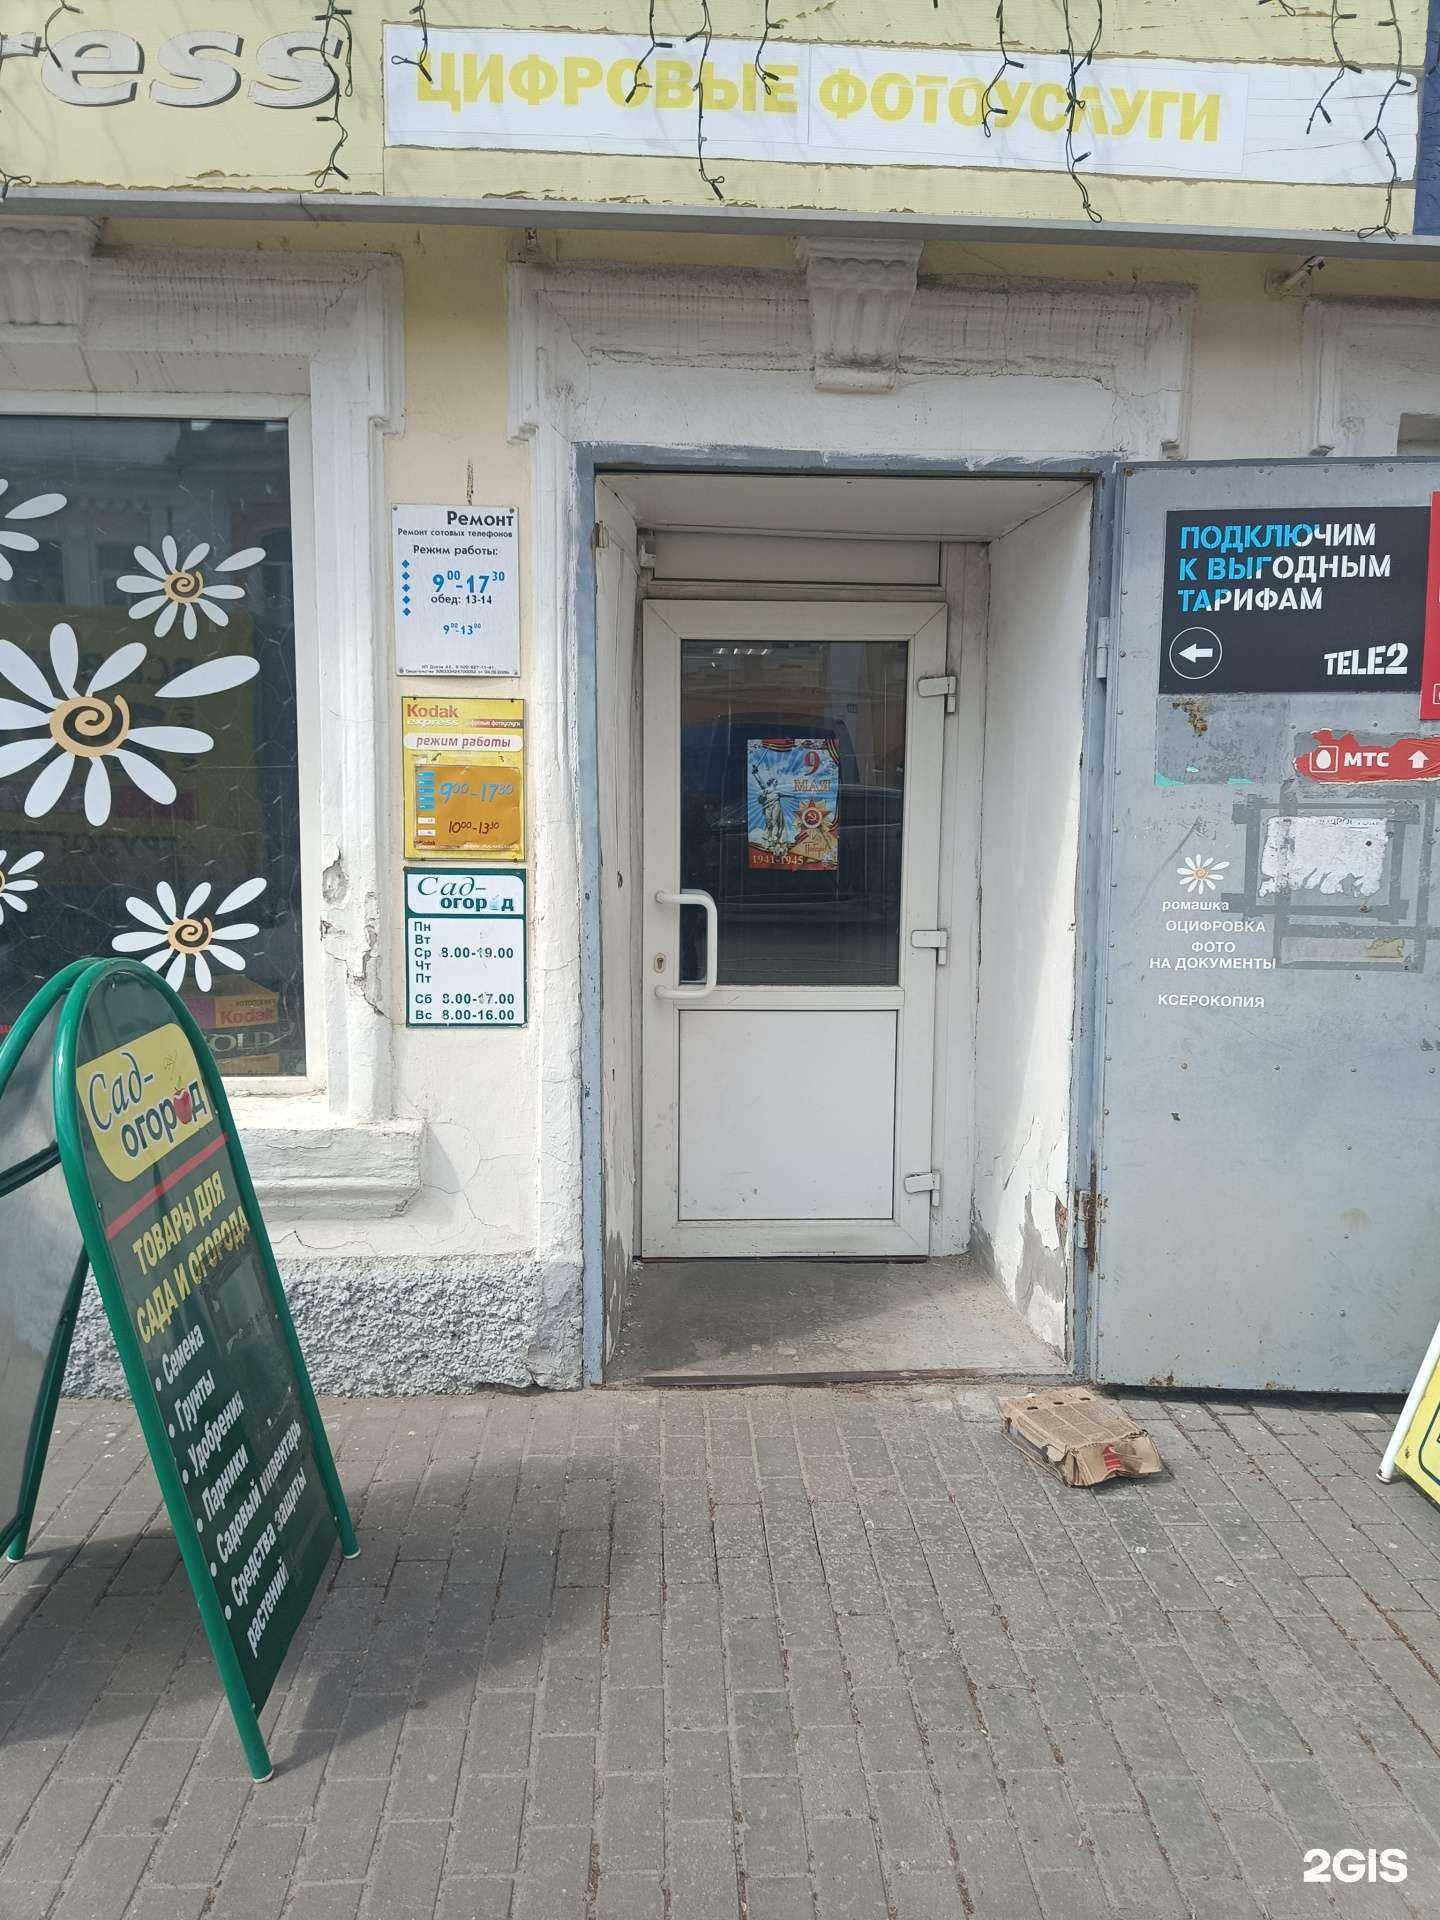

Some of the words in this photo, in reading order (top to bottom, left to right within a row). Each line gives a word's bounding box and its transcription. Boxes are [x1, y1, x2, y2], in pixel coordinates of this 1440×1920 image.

[417, 52, 799, 114] ЦИФРОВЫЕ
[818, 68, 1221, 142] ФОТОУСЛУГИ
[447, 511, 514, 527] Ремонт
[397, 528, 428, 536] Ремонт
[430, 529, 465, 537] сотовых
[468, 530, 513, 538] телефонов
[1180, 523, 1376, 553] ПОДКЛЮЧИМ
[413, 545, 450, 555] Режим
[454, 546, 498, 556] работы:
[1179, 558, 1197, 581] К
[1207, 554, 1391, 583] ВЫГОДНЫМ
[431, 594, 461, 605] обед:
[466, 595, 492, 604] 13-14
[1177, 587, 1323, 612] ТАРИФАМ
[1323, 642, 1408, 676] TELE2
[407, 704, 459, 718] Kodak
[416, 736, 458, 748] режим
[462, 736, 511, 748] работы
[803, 751, 821, 776] 9
[1344, 752, 1390, 767] МТС
[417, 876, 486, 896] Сад-
[440, 897, 514, 912] огорд
[1162, 901, 1230, 912] ромашка
[414, 922, 431, 931] Пн
[1165, 920, 1266, 933] ОЦИФРОВКА
[415, 935, 431, 944] Вт
[1191, 941, 1236, 953] ФОТО
[414, 948, 431, 959] Ср
[415, 961, 431, 970] Чт
[1150, 957, 1171, 969] НА
[1175, 957, 1276, 971] ДОКУМЕНТЫ
[415, 974, 431, 983] Пт
[415, 994, 432, 1004] Сб
[1158, 994, 1265, 1008] КСЕРОКОПИЯ
[415, 1010, 432, 1020] Вс
[442, 1010, 514, 1020] 8.00-16.00
[205, 1031, 274, 1052] OLD
[89, 1052, 154, 1130] Сад-
[121, 1080, 208, 1158] огорд
[132, 1196, 196, 1275] ТОВАРЫ
[194, 1170, 226, 1228] ДЛЯ
[136, 1278, 178, 1344] САДА
[173, 1263, 191, 1296] И
[188, 1205, 251, 1286] ОГОРОДА
[162, 1324, 204, 1385] Семена
[174, 1369, 216, 1432] Грунты
[187, 1390, 245, 1478] Удобрения
[201, 1444, 249, 1522] Парники
[216, 1480, 262, 1564] Садовый
[259, 1420, 302, 1496] инвентарь
[230, 1522, 277, 1607] Средства
[274, 1467, 307, 1533] защиты
[246, 1556, 290, 1659] растений
